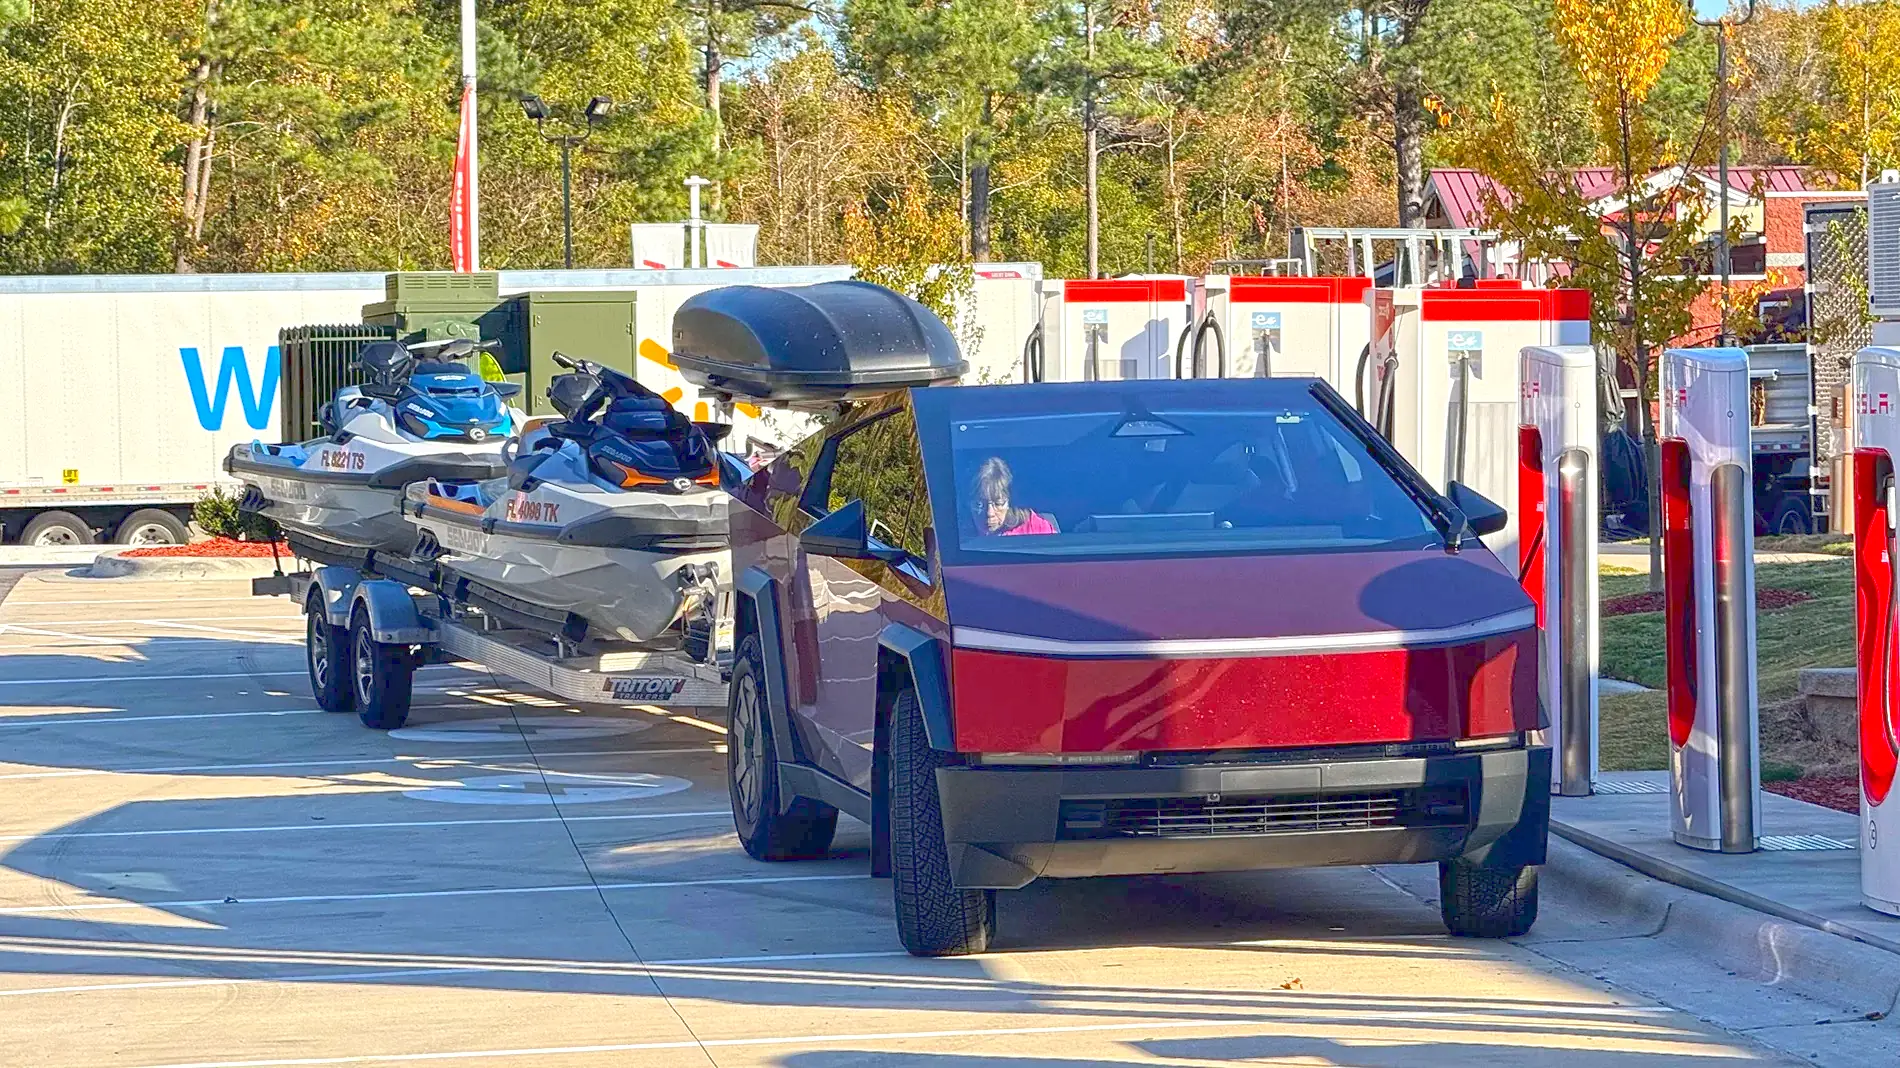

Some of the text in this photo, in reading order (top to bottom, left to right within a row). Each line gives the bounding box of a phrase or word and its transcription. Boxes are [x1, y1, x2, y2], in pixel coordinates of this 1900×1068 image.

[352, 452, 365, 470] TS
[505, 499, 517, 519] FL
[544, 503, 560, 523] TK
[610, 678, 676, 693] TRITON
